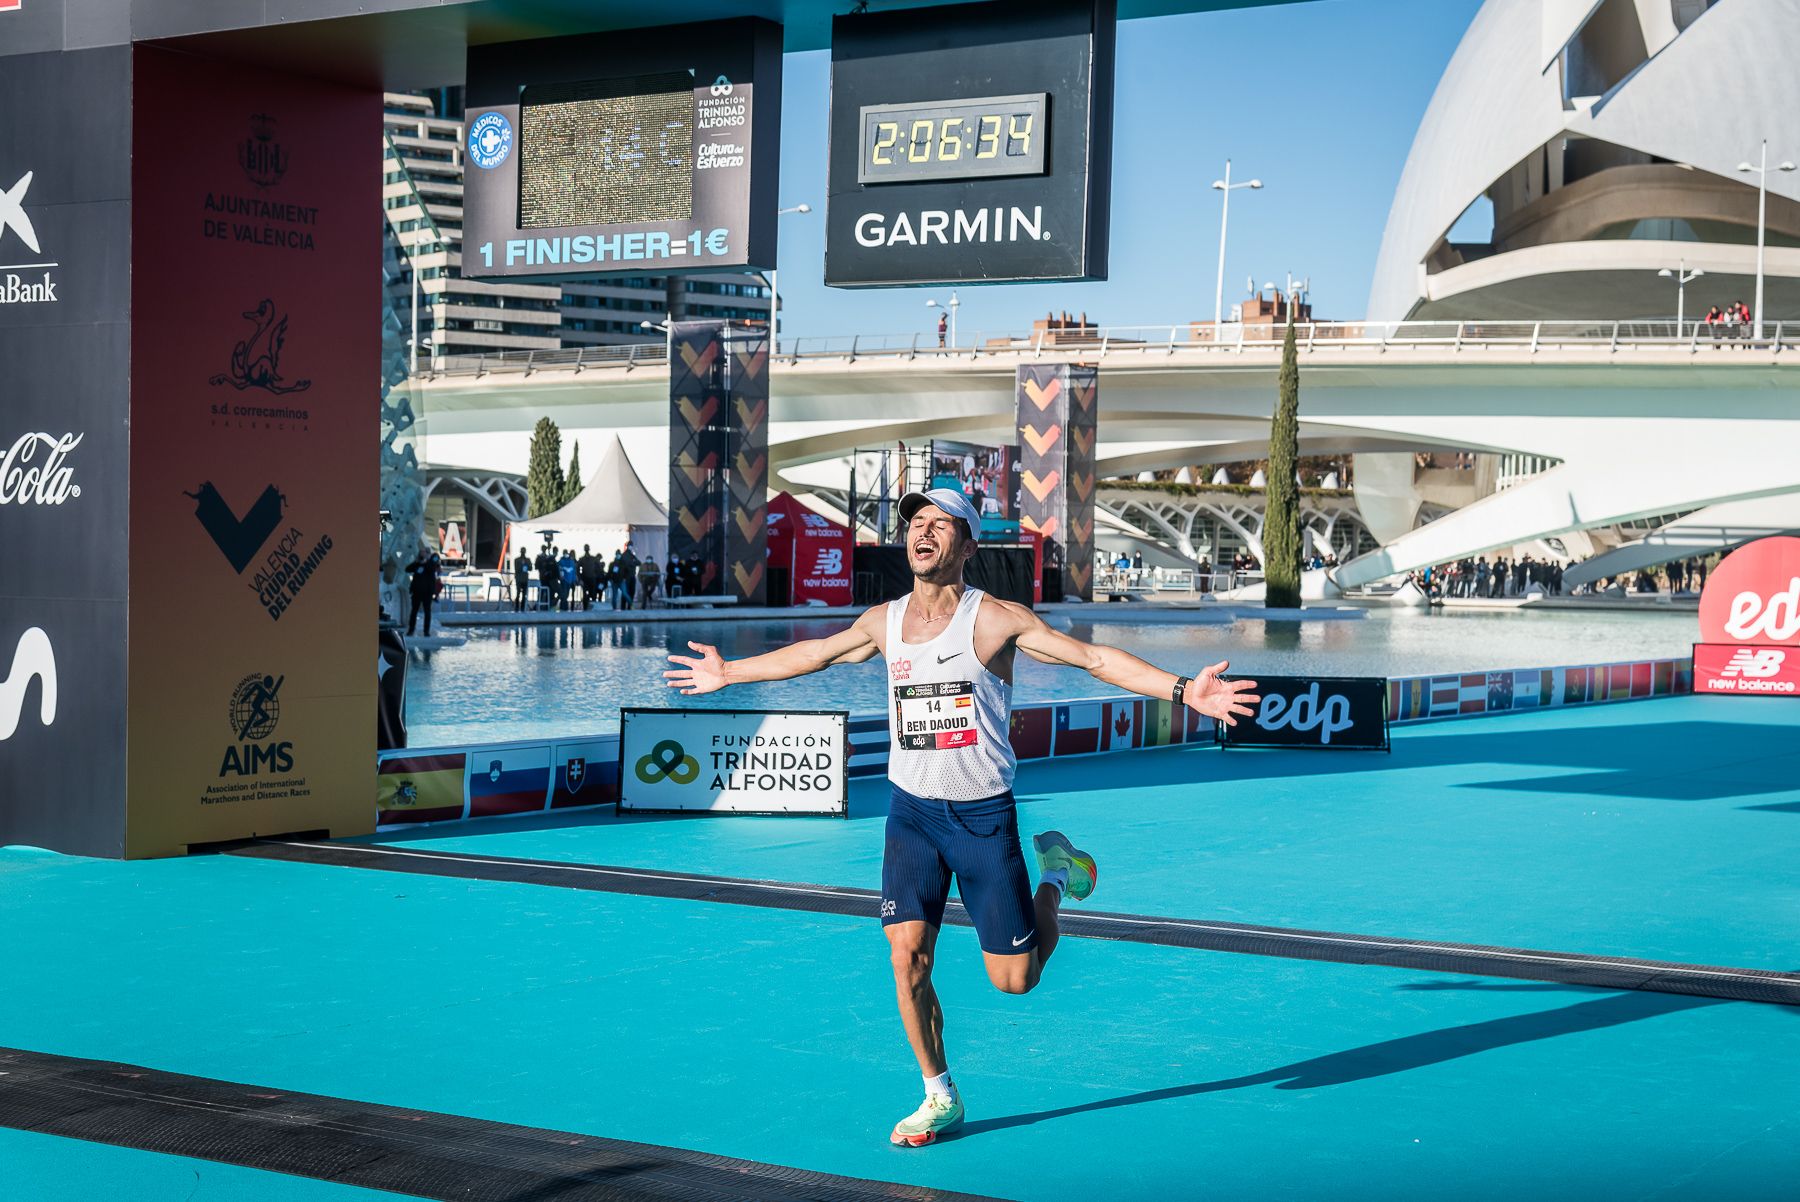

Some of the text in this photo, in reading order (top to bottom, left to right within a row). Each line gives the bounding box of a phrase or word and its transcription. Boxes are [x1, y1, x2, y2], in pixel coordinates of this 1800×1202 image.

[699, 96, 745, 107] FUNDACIÓN
[698, 105, 745, 118] TRINIDAD
[472, 116, 503, 138] MÉDICOS
[698, 116, 745, 129] ALFONSO
[872, 114, 1032, 165] 2:06:34
[471, 144, 508, 165] DEL MUNDO
[698, 143, 735, 156] Cultura
[697, 155, 744, 169] Esfuerzo
[204, 192, 319, 225] AJUNTAMENT
[204, 219, 315, 251] DE VALÈNCIA
[855, 206, 1042, 247] GARMIN
[480, 242, 493, 267] 1
[233, 406, 309, 420] correcaminos
[248, 528, 303, 592] VALENCIA
[260, 553, 300, 606] CIUDAD
[268, 534, 333, 621] DEL RUNNING
[1724, 577, 1800, 641] ed
[232, 672, 262, 697] RUNNING
[1708, 678, 1795, 692] new balance
[926, 700, 941, 713] 14
[1256, 682, 1354, 744] edp
[907, 717, 968, 732] BEN DAOUD
[712, 734, 831, 747] FUNDACIÓN
[219, 742, 294, 777] AIMS
[710, 752, 832, 770] TRINIDAD
[206, 778, 306, 793] Association of International
[709, 774, 832, 791] ALFONSO
[200, 788, 310, 805] Marathons and Distance Races
